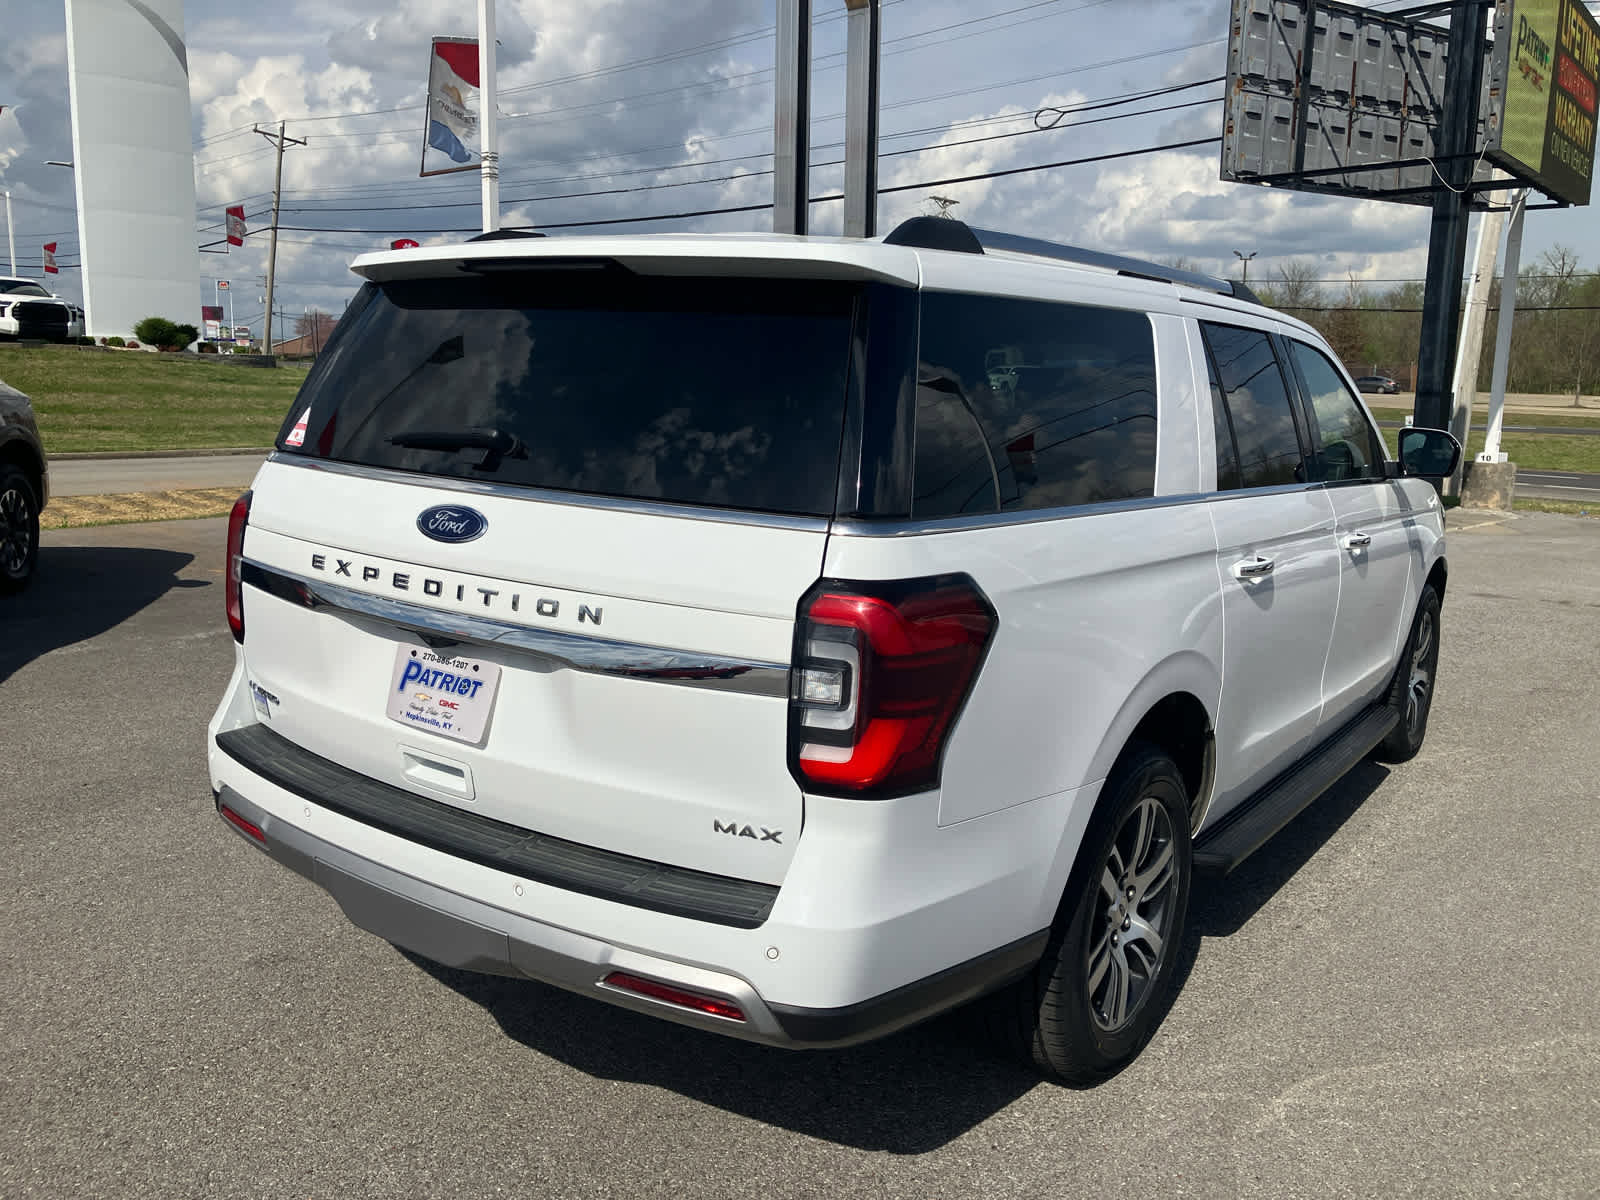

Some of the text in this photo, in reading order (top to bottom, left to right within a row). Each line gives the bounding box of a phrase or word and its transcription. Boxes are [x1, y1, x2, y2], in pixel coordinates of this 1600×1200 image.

[428, 510, 470, 534] Ford
[311, 554, 604, 626] EXPEDITION
[398, 659, 484, 698] PATRIOT
[439, 699, 460, 710] GMC
[442, 721, 453, 730] KY
[713, 819, 783, 845] MAX
